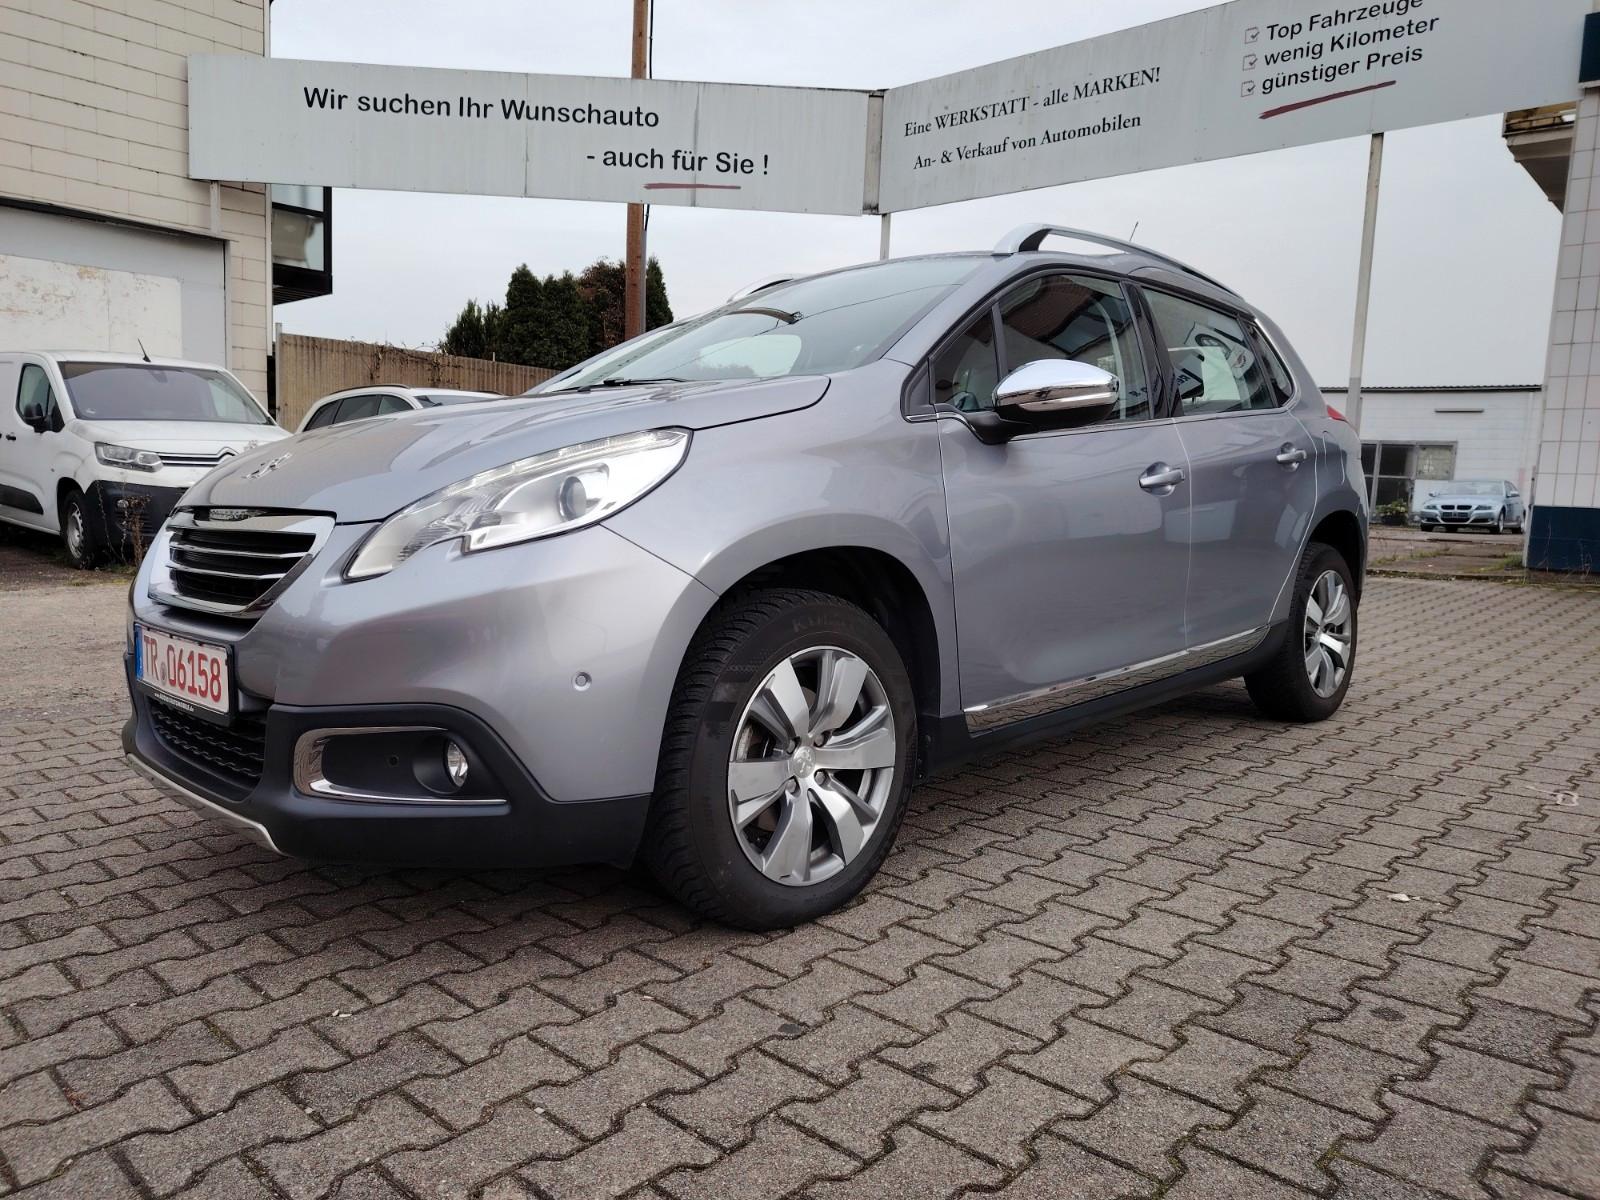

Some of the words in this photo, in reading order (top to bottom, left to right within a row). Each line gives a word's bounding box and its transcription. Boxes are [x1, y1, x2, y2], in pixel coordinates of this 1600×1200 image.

[1264, 42, 1324, 66] wenig
[1330, 17, 1440, 53] Kilometer
[1266, 22, 1303, 41] Top
[1308, 0, 1423, 32] Fahrzeuge
[1261, 60, 1361, 95] günstiger
[1366, 45, 1423, 71] Preis
[303, 86, 349, 110] Wir
[357, 93, 451, 117] suchen
[459, 96, 494, 119] Ihr
[500, 98, 659, 128] Wunschauto
[904, 121, 932, 137] Eine
[935, 96, 1031, 130] WERKSTATT
[1042, 89, 1069, 107] alle
[1073, 66, 1161, 101] MARKEN!
[602, 147, 664, 170] auch
[671, 149, 709, 172] für
[715, 151, 754, 175] Sie
[913, 155, 937, 170] An-
[940, 150, 952, 164] &
[955, 137, 1010, 161] Verkauf
[1011, 138, 1037, 150] von
[1040, 116, 1141, 145] Automobilen
[143, 634, 159, 681] TR
[167, 644, 222, 703] 06158
